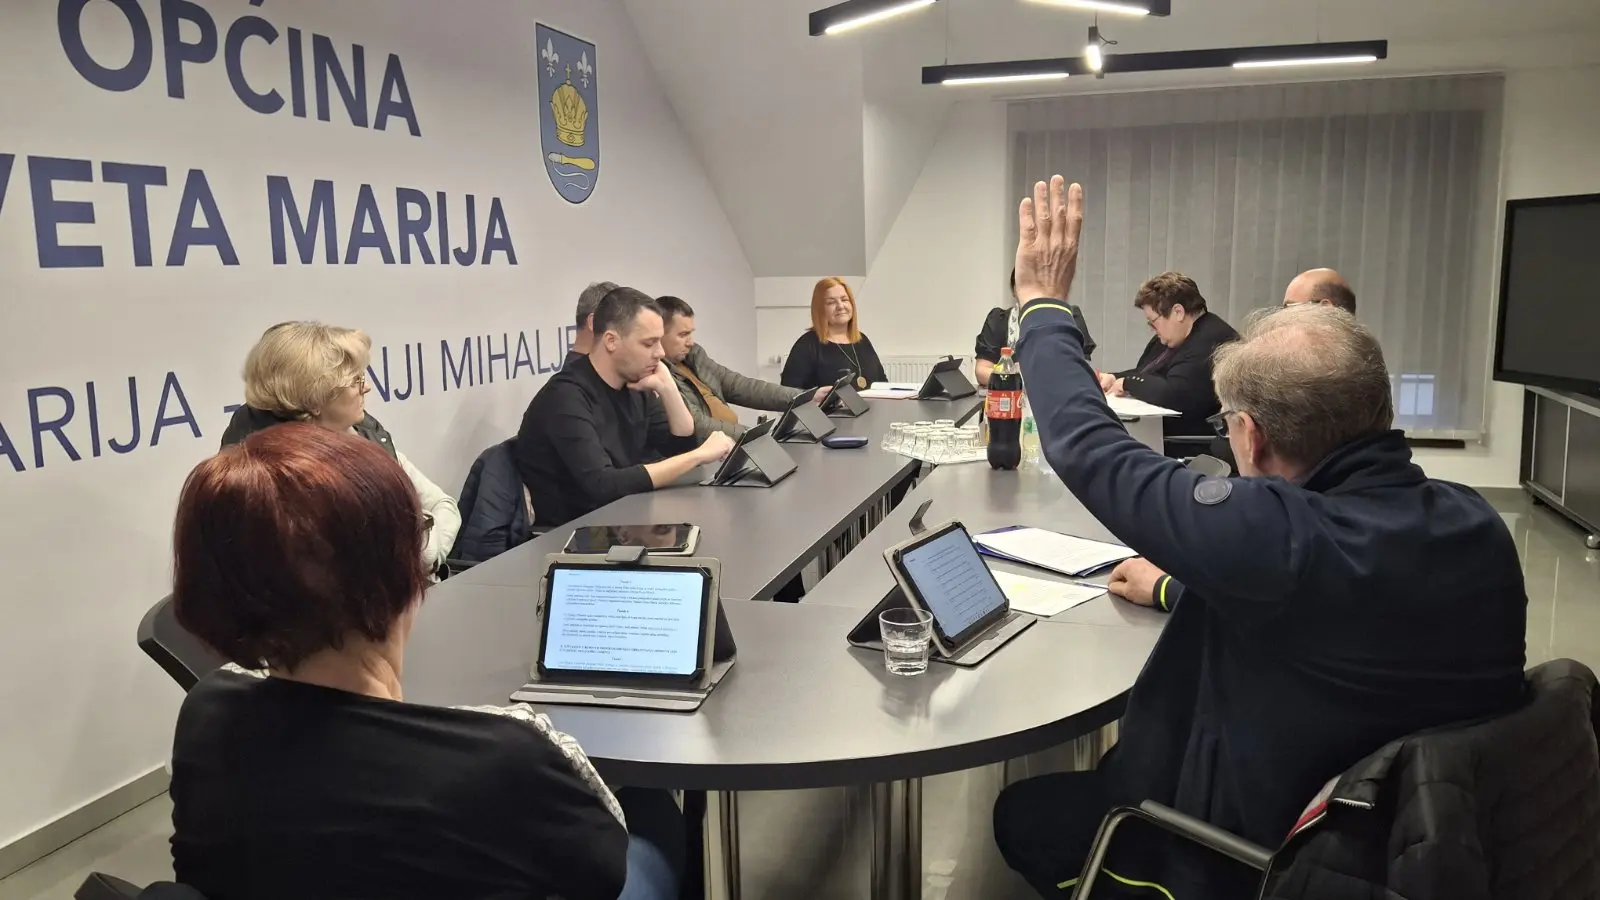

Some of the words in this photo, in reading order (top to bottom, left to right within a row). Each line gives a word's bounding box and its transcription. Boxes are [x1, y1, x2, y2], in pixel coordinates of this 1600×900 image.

[57, 0, 421, 137] OPĆINA
[0, 154, 240, 268] ETA
[266, 175, 518, 267] MARIJA
